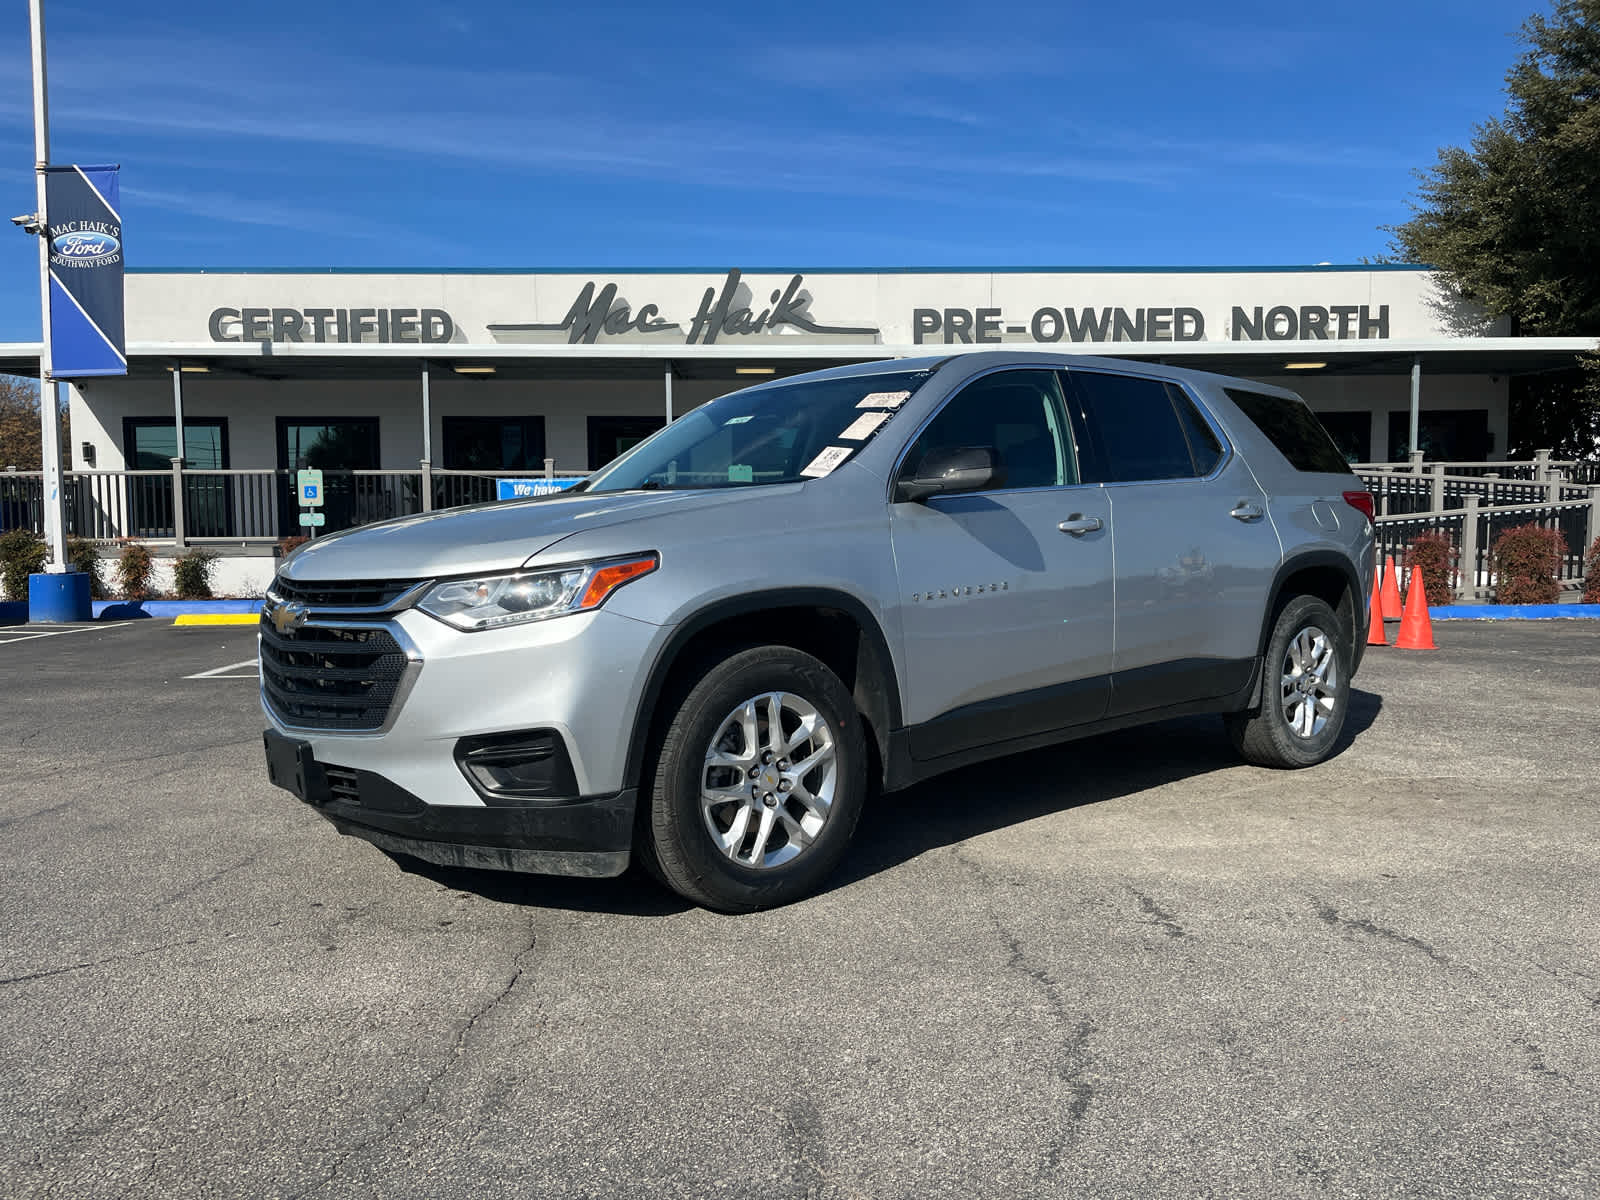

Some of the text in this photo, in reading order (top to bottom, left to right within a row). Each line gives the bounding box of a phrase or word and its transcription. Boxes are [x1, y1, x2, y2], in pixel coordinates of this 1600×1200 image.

[51, 220, 120, 237] MAC HAIK'S
[63, 236, 105, 255] Ford
[50, 254, 120, 268] SOUTHWAY FORD
[487, 267, 880, 344] Mac Haik
[208, 307, 453, 343] CERTIFIED
[913, 305, 1389, 344] PRE-OWNED NORTH
[513, 484, 562, 496] We have
